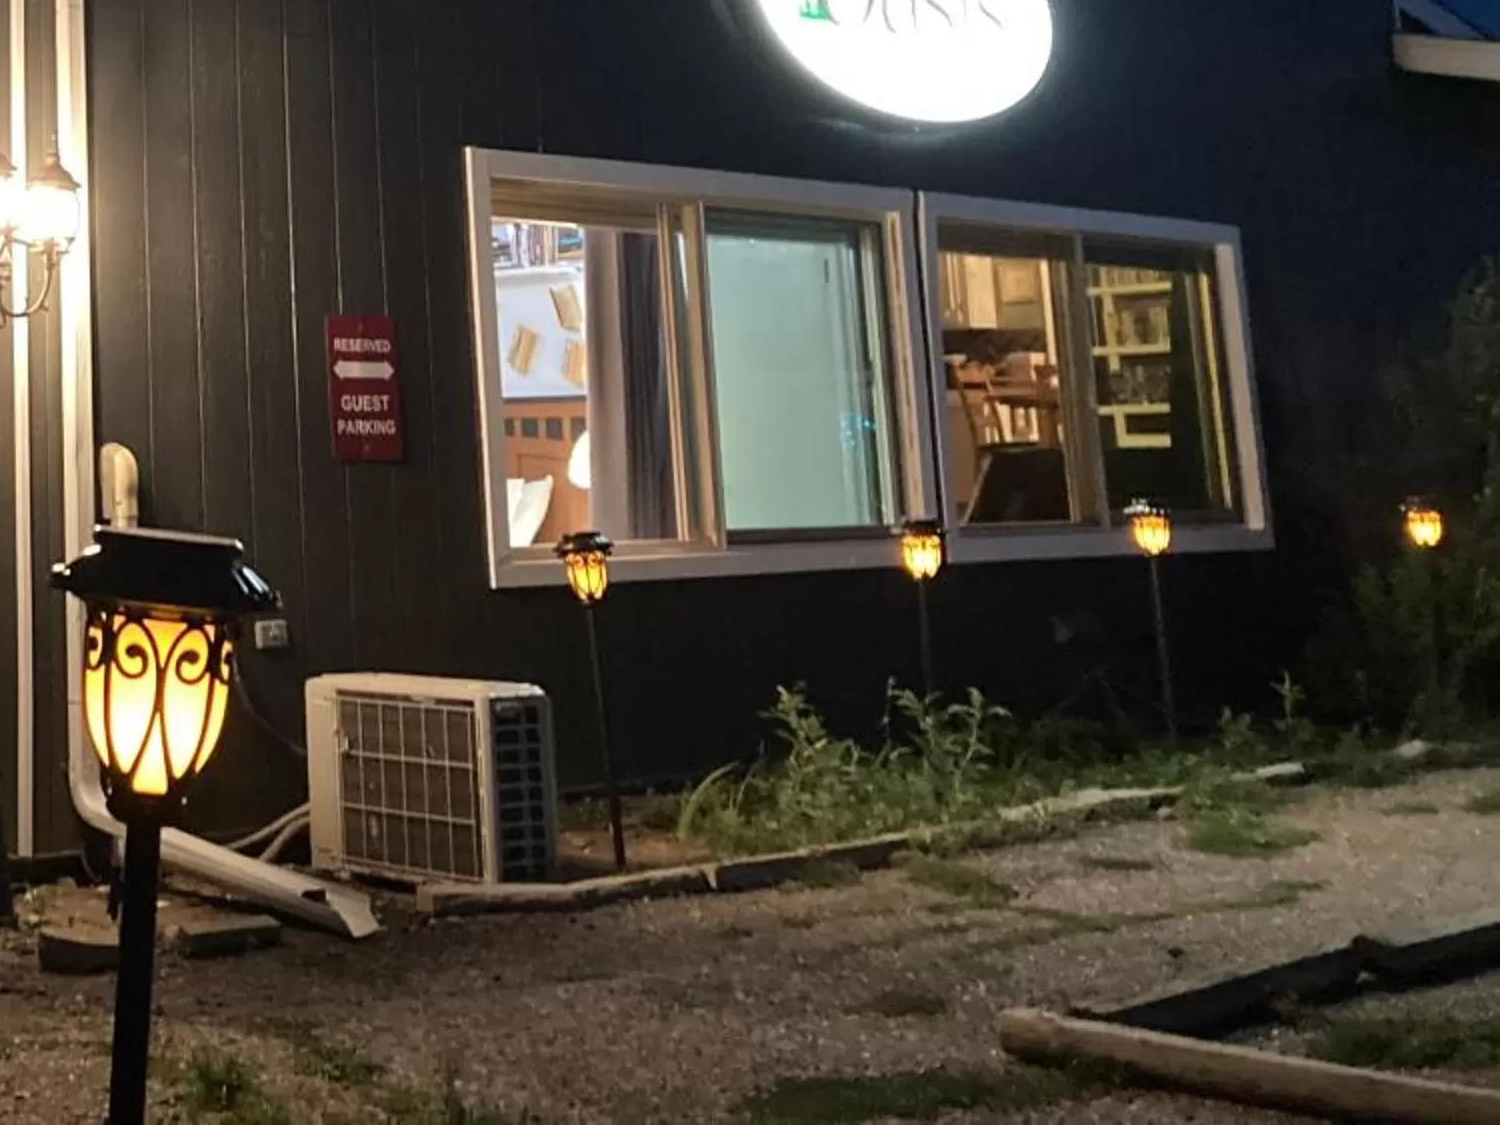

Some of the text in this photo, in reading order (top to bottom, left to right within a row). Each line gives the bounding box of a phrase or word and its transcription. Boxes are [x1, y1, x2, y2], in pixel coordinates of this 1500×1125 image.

[333, 337, 392, 353] RESERVED
[341, 395, 390, 412] GUEST
[337, 419, 396, 435] PARKING
